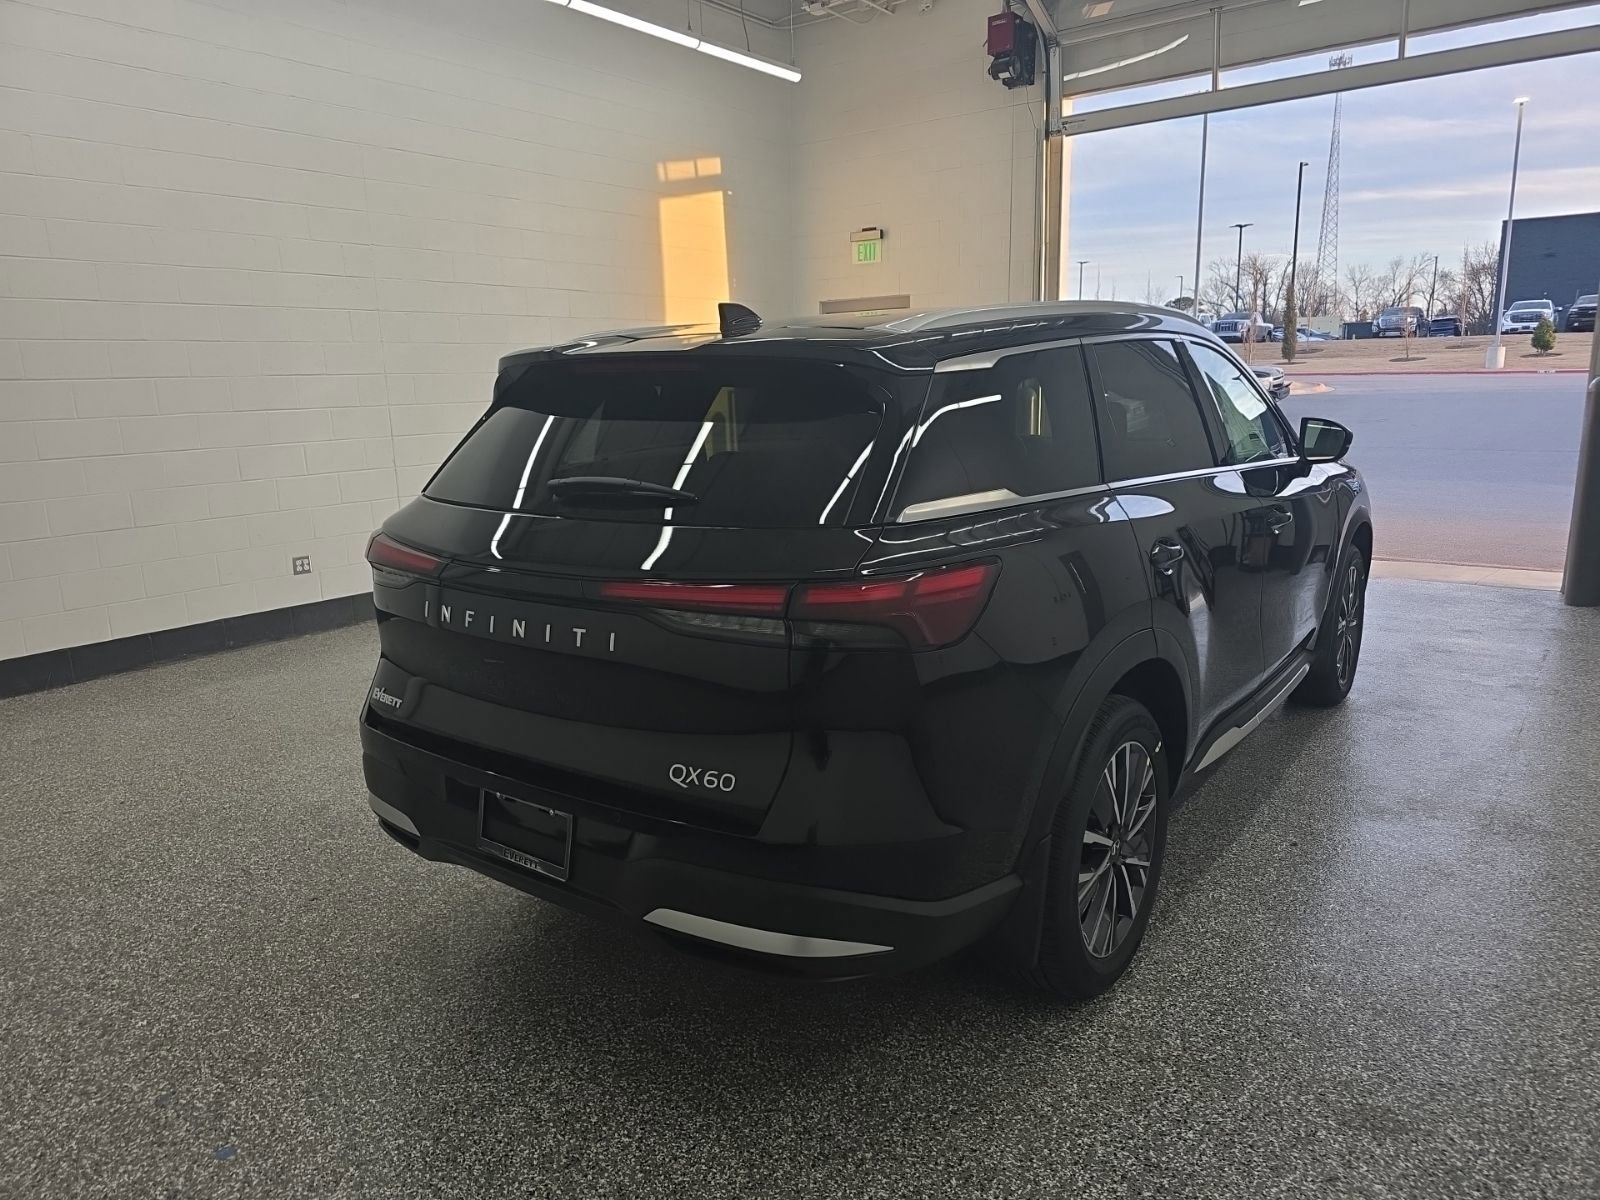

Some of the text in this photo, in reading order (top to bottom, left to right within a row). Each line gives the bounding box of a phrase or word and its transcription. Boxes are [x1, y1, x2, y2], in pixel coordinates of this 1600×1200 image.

[857, 242, 877, 262] EXIT
[424, 600, 615, 652] INFINITI
[372, 687, 403, 709] EVERETT
[669, 763, 736, 792] QX60
[503, 847, 541, 870] EVERETT
